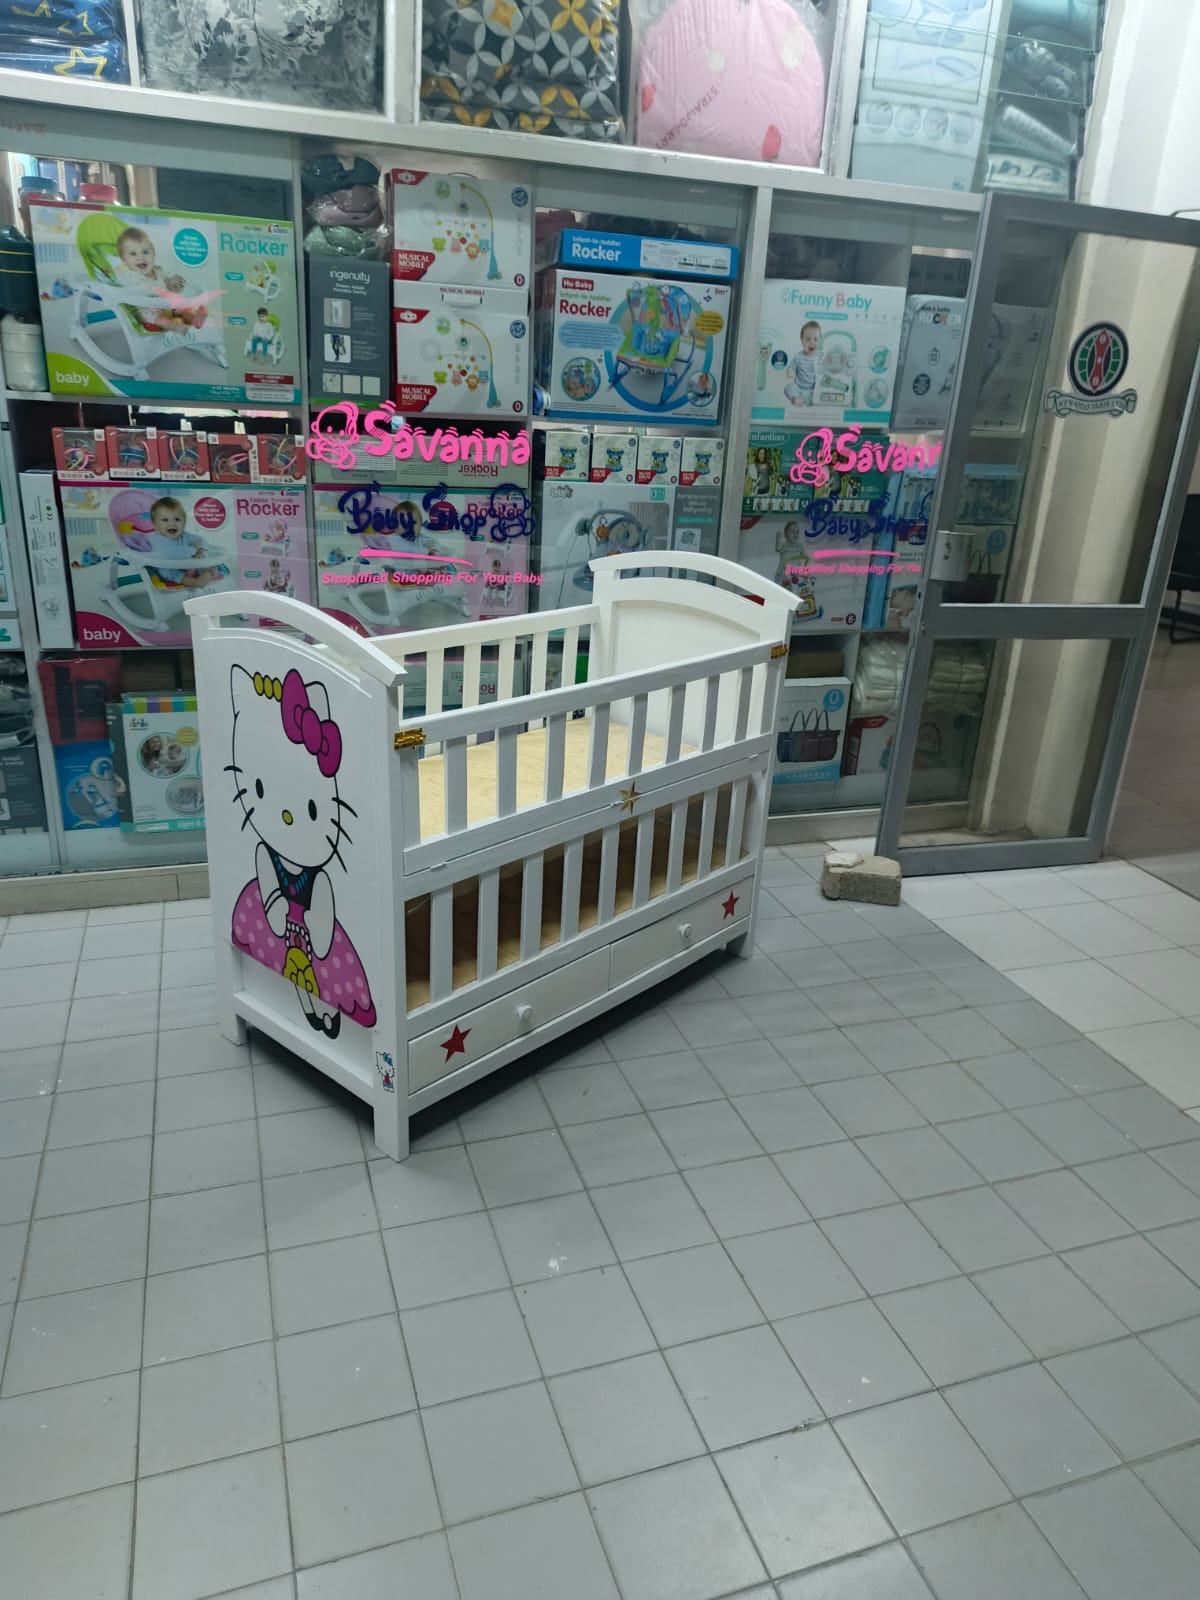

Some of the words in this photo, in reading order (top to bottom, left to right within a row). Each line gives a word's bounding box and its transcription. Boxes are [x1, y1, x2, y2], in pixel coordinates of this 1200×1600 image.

[219, 231, 288, 257] Rocker
[398, 252, 429, 263] MUSICAL
[571, 243, 621, 262] Rocker
[398, 260, 425, 269] MOBILE
[329, 268, 371, 284] ingenuity
[440, 287, 463, 295] MUSICAL
[464, 289, 485, 297] MOBILE
[559, 299, 612, 317] Rocker
[790, 289, 833, 310] Funny
[835, 292, 872, 312] Baby
[55, 370, 90, 388] baby
[401, 386, 431, 396] MUSICAL
[401, 393, 428, 402] MOBILE
[363, 401, 531, 467] Savanna
[749, 431, 785, 442] nfantino
[458, 464, 499, 477] Rocker
[236, 498, 300, 517] Rocker
[338, 482, 417, 541] Baby
[422, 483, 487, 541] Shop
[467, 502, 523, 518] Roker
[804, 495, 862, 544] Baby
[886, 563, 904, 574] For
[322, 571, 389, 585] Simplified
[392, 572, 454, 585] Shopping
[457, 573, 478, 583] For
[482, 573, 510, 584] Your
[512, 573, 543, 586] Baby
[83, 627, 121, 643] baby
